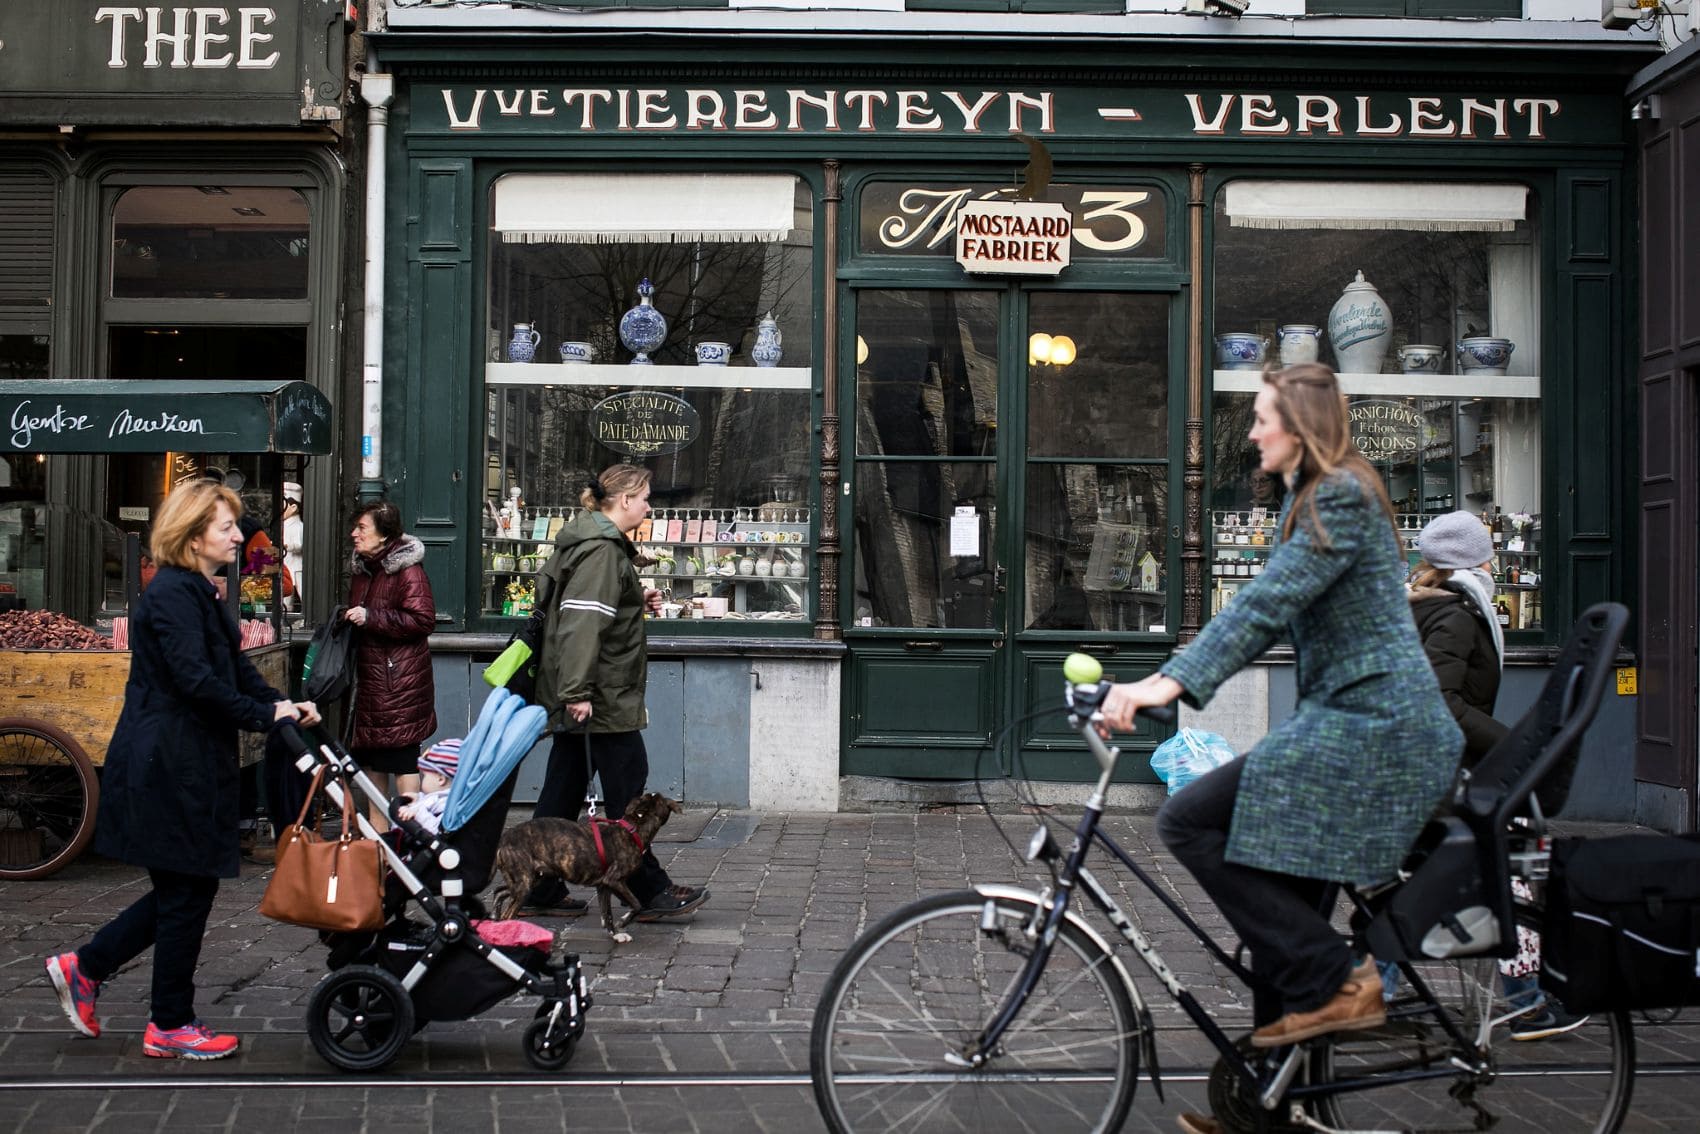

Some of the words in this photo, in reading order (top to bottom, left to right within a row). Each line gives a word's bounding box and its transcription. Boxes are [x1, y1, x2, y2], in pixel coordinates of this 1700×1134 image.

[95, 7, 280, 68] THEE
[563, 88, 1055, 133] TIERENTEYN
[1184, 94, 1562, 138] VERLENT
[960, 214, 1070, 238] MOSTAARD
[1072, 192, 1149, 251] 3
[963, 239, 1063, 262] FABRIEK
[637, 411, 654, 419] DE
[1347, 406, 1419, 428] ORNICHONS
[1352, 436, 1416, 450] IGNONS
[175, 455, 198, 473] 5€
[1172, 524, 1180, 538] 3
